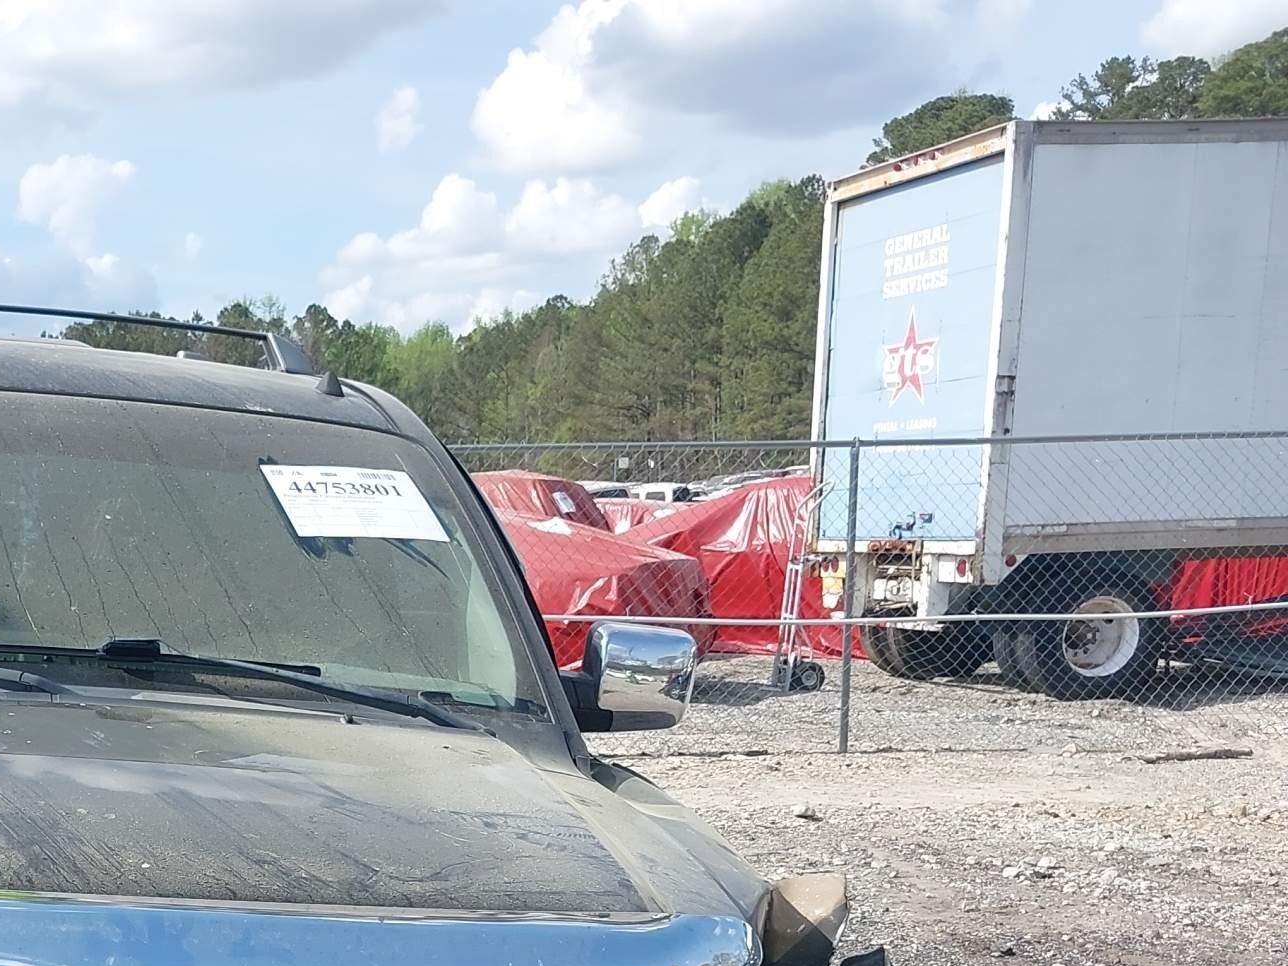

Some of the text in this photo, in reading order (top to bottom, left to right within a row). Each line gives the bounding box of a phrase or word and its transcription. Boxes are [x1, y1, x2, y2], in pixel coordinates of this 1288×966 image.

[885, 223, 951, 257] GENERAL
[883, 245, 950, 278] TRAILER
[881, 268, 950, 299] SERVICES
[288, 481, 404, 498] 44753801
